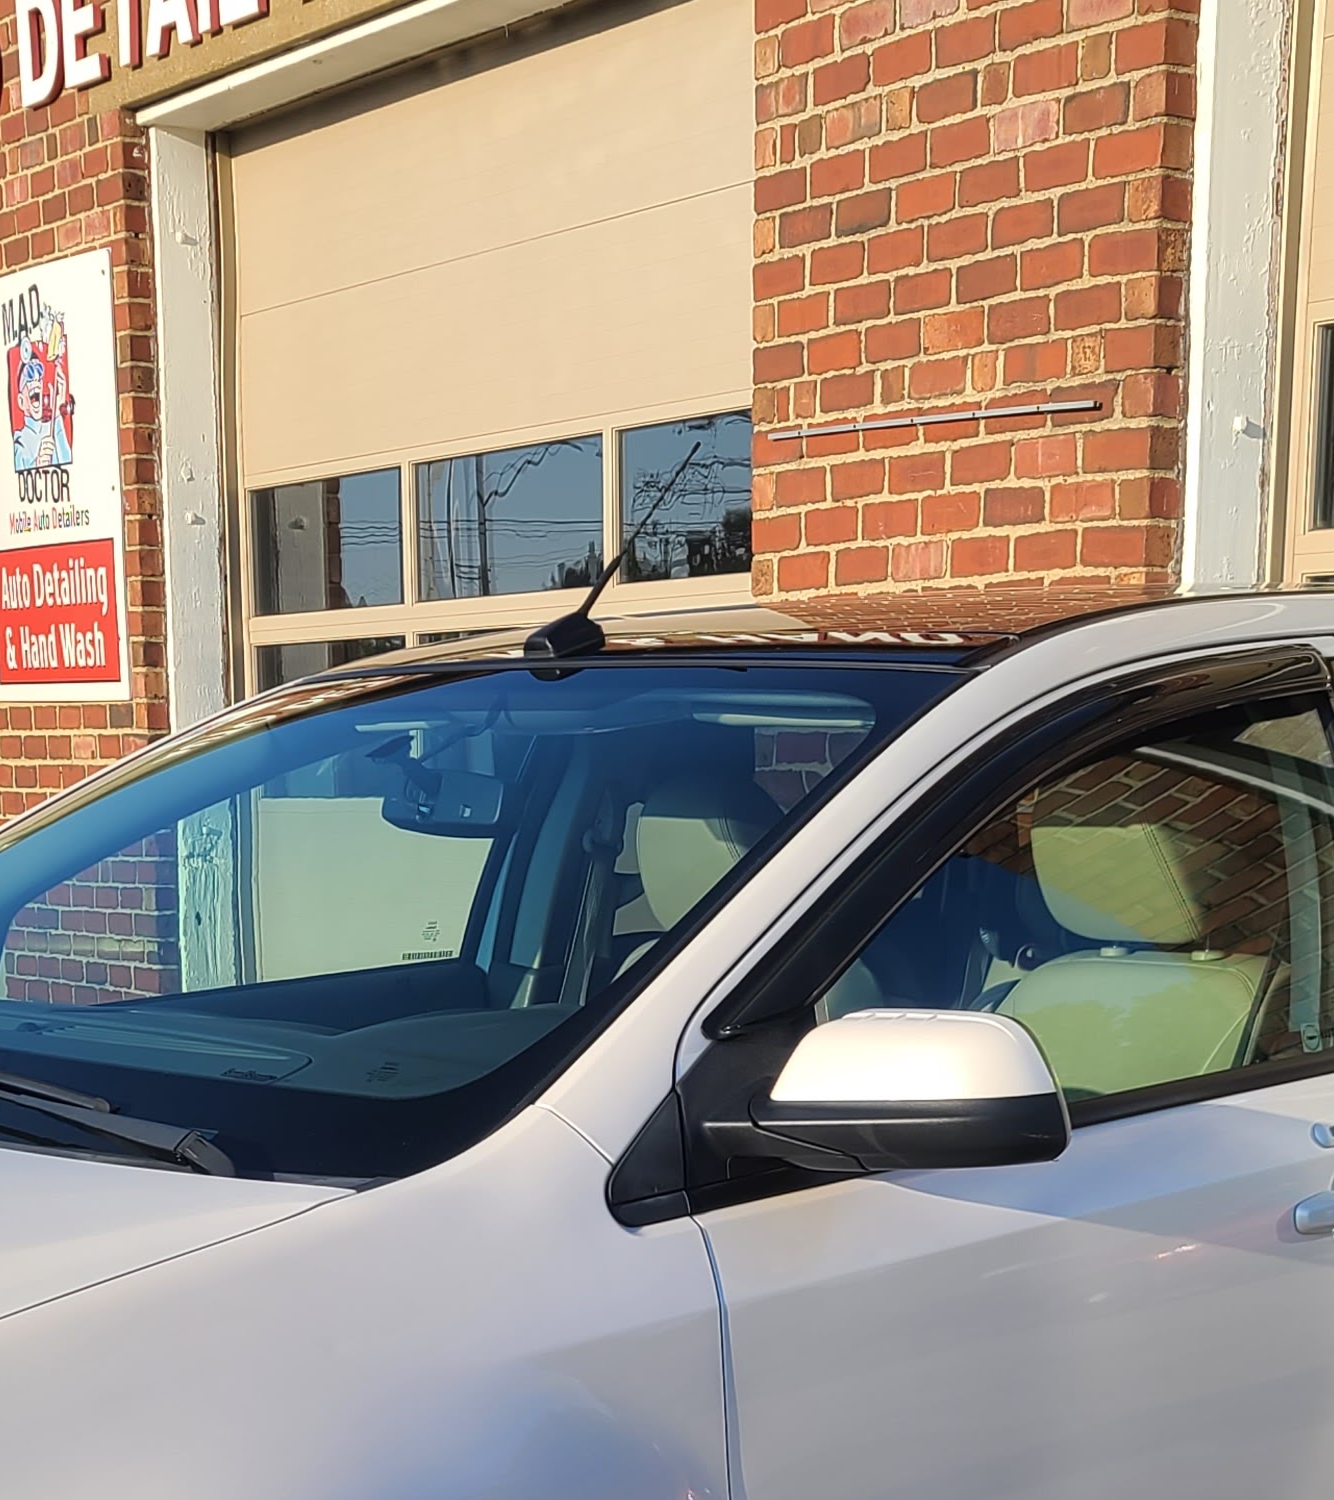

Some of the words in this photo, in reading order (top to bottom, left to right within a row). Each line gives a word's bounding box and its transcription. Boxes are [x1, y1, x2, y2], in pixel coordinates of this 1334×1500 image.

[17, 0, 269, 109] DET
[1, 283, 44, 346] M.A.D.
[17, 468, 71, 504] DOCTOR
[9, 510, 32, 535] Mobile
[33, 509, 50, 531] Auto
[52, 504, 90, 529] Detailers
[1, 566, 31, 610] Auto
[32, 557, 109, 616] Detailing
[5, 626, 18, 670] &
[19, 623, 59, 670] Hand
[59, 621, 106, 668] Wash
